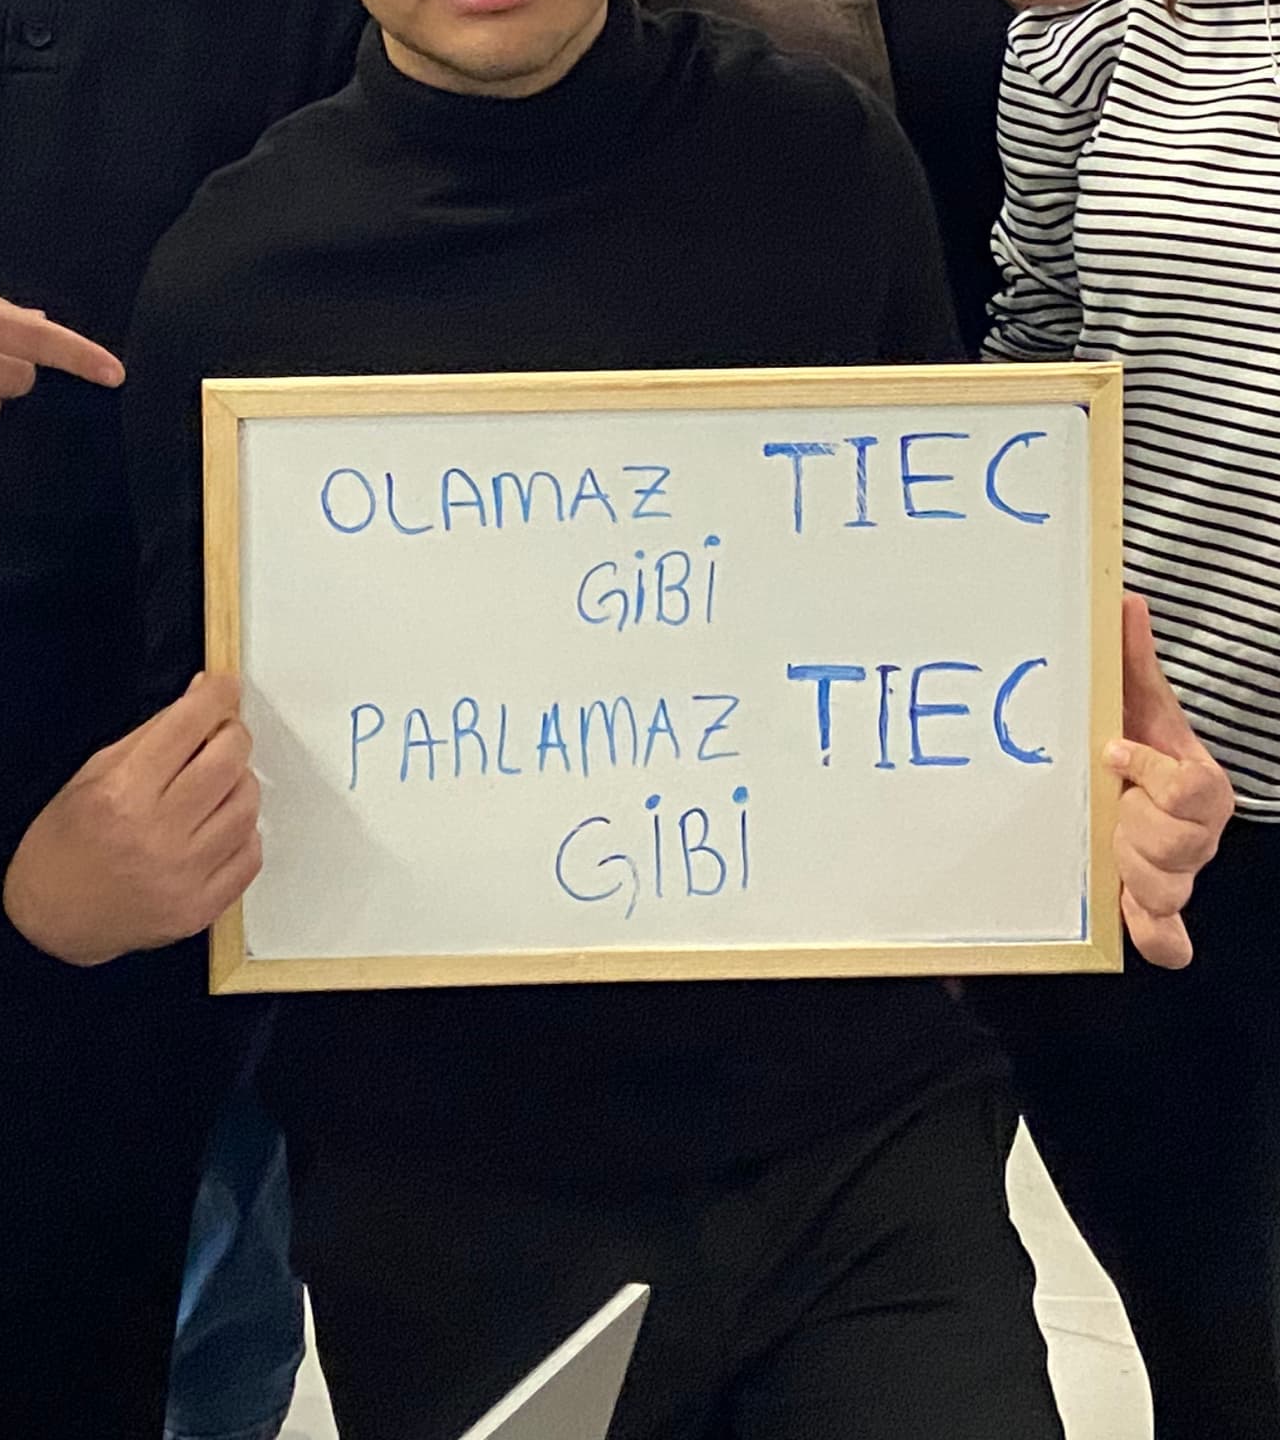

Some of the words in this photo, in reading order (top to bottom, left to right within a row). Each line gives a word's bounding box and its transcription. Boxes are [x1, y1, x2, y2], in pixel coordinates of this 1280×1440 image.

[320, 465, 672, 534] OLAMAZ
[763, 431, 1051, 533] TIEC
[349, 693, 742, 791] PARLAMAZ
[786, 656, 1053, 769] TIEC
